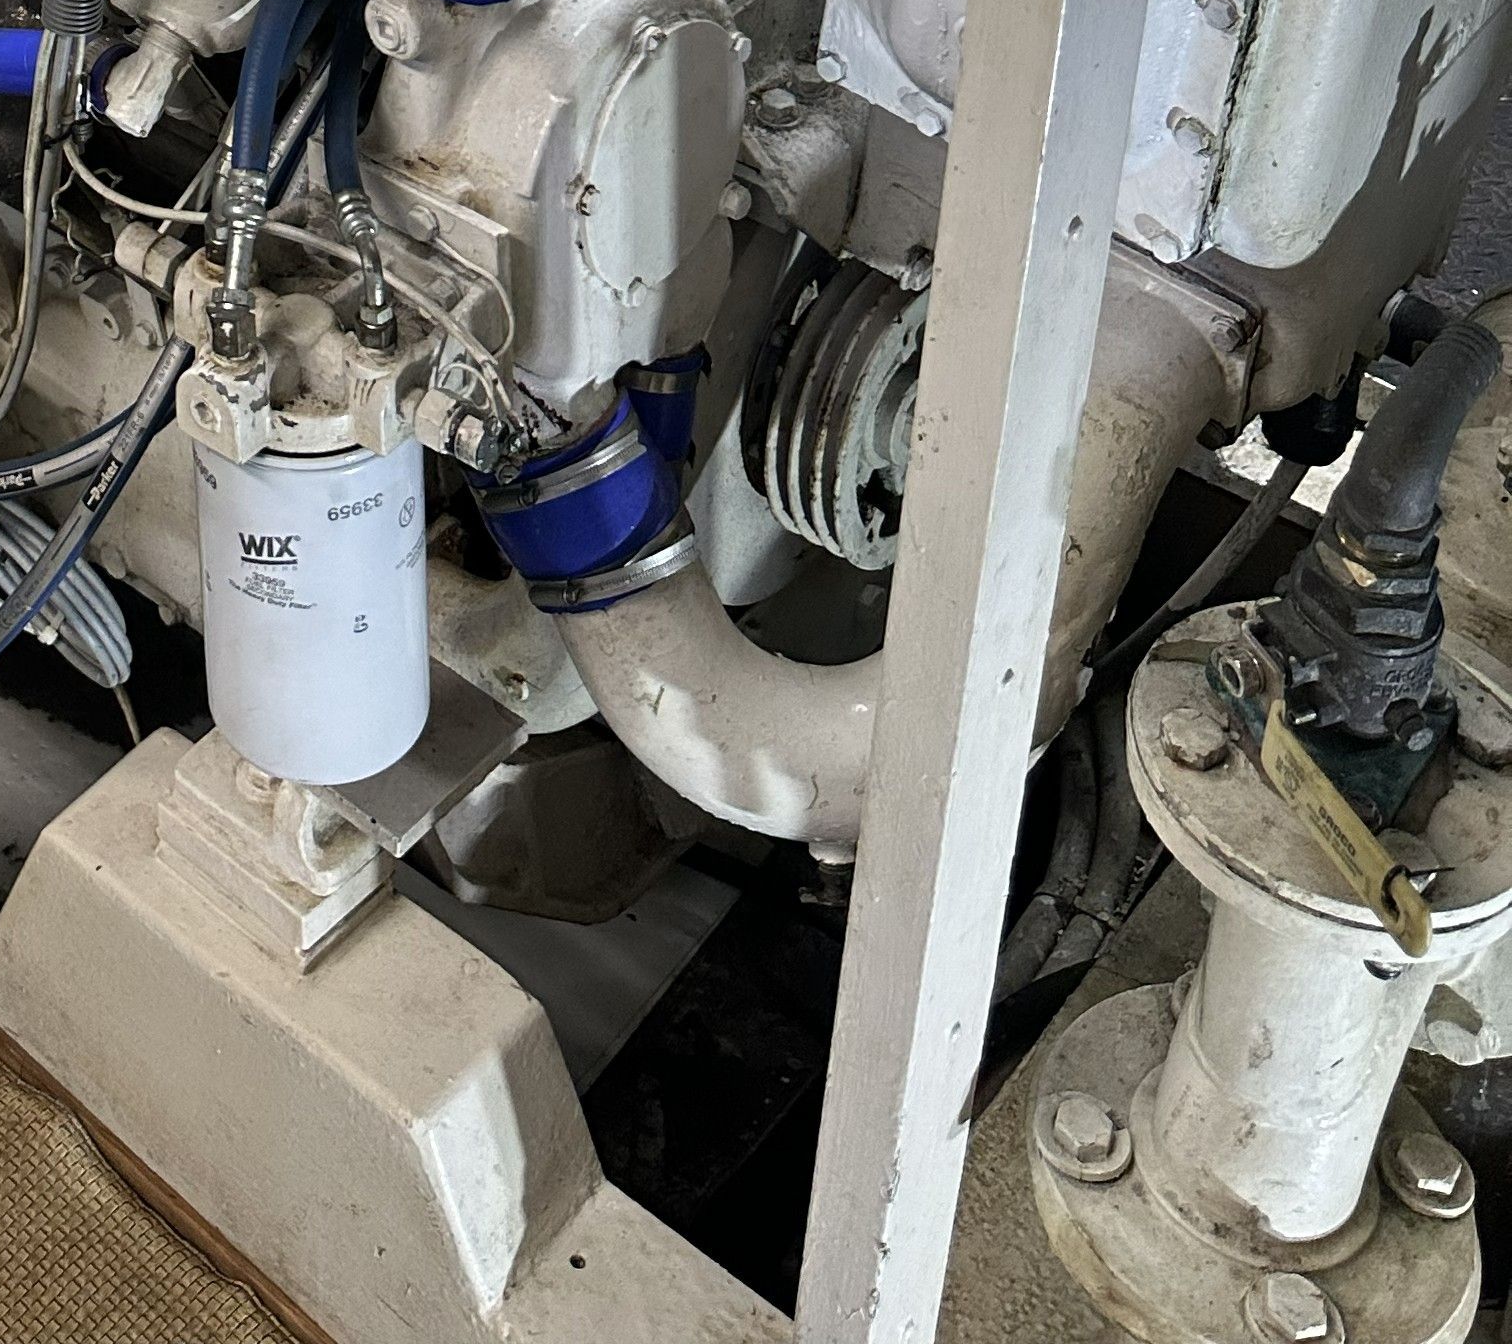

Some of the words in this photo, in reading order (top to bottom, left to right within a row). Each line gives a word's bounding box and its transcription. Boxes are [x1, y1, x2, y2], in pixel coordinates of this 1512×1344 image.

[88, 460, 120, 505] Parker
[327, 492, 384, 522] 33959
[238, 531, 298, 558] WIX
